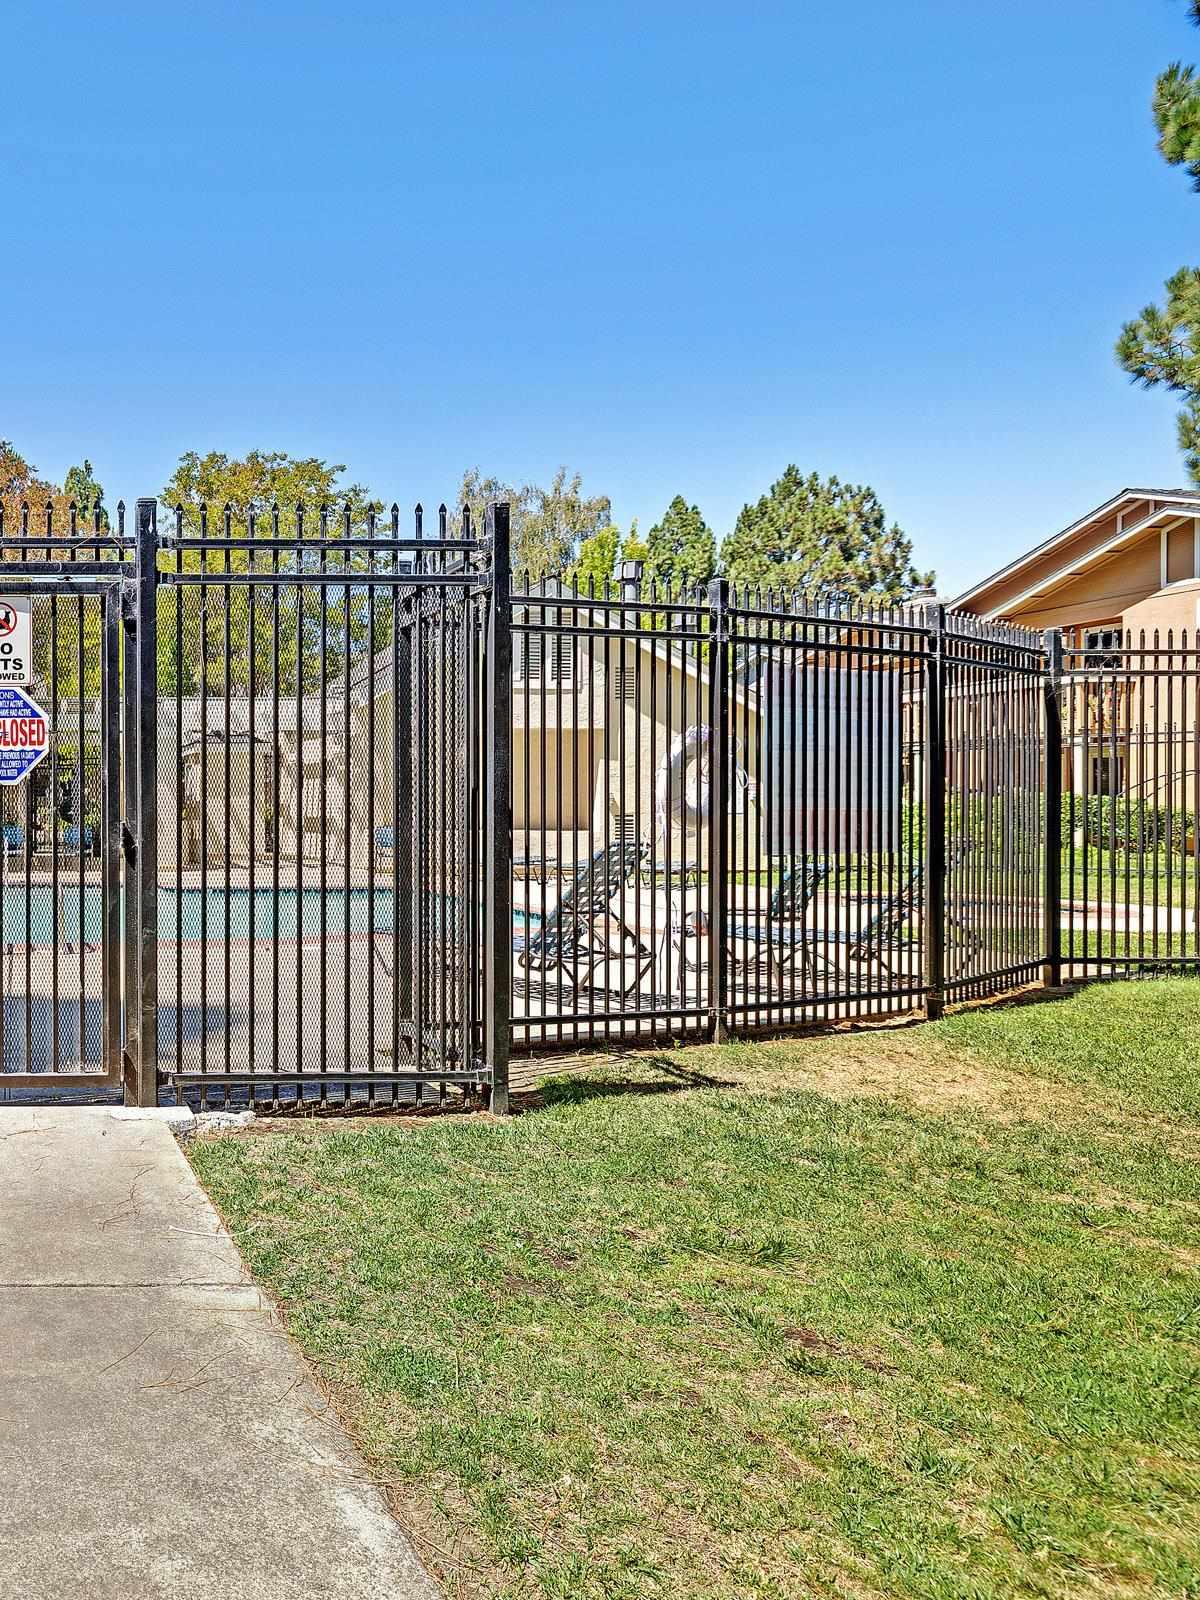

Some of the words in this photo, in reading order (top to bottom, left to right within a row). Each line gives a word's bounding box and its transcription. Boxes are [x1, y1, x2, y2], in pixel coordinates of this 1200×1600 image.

[10, 700, 24, 708] ACTIVE
[18, 709, 32, 717] ACTIVE
[1, 760, 22, 768] ALLOWED
[22, 760, 28, 768] TO
